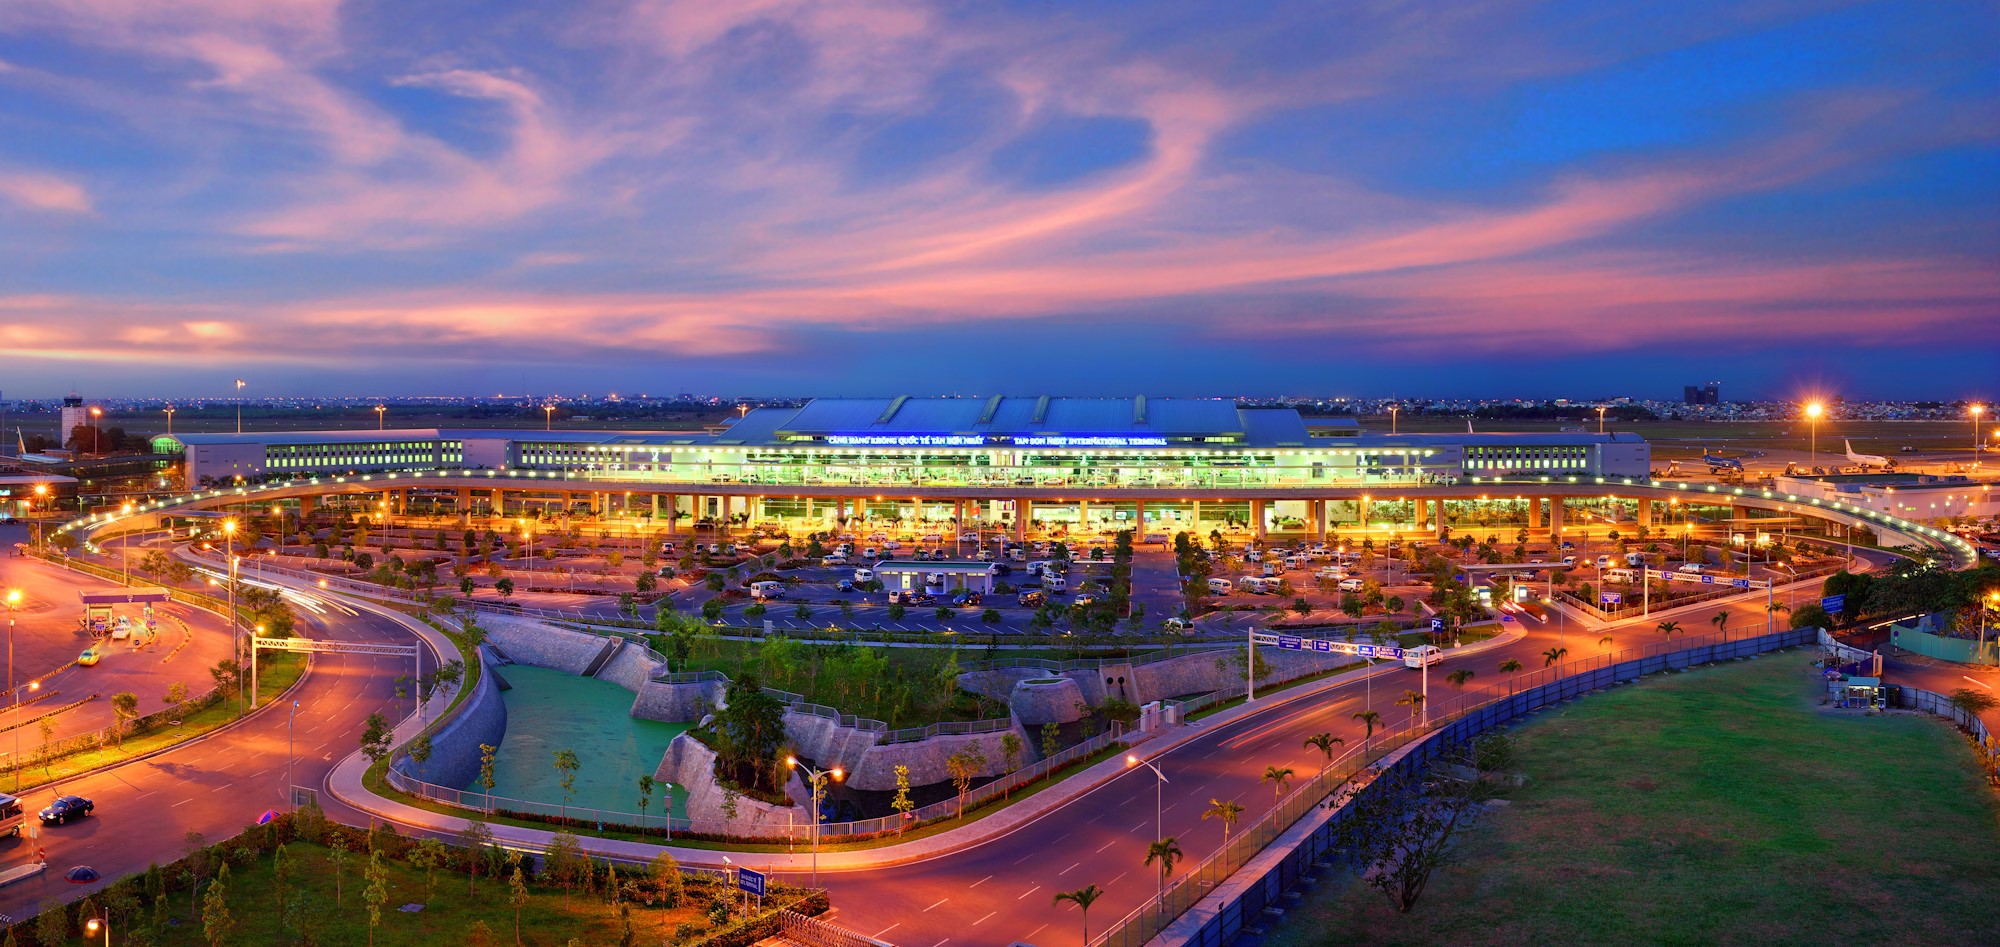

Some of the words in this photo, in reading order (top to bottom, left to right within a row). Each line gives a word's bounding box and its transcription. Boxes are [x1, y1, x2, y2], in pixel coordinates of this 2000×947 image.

[1030, 436, 1046, 445] SON
[1068, 436, 1128, 445] INTERNATIONAL
[1128, 437, 1167, 445] TERMINAL
